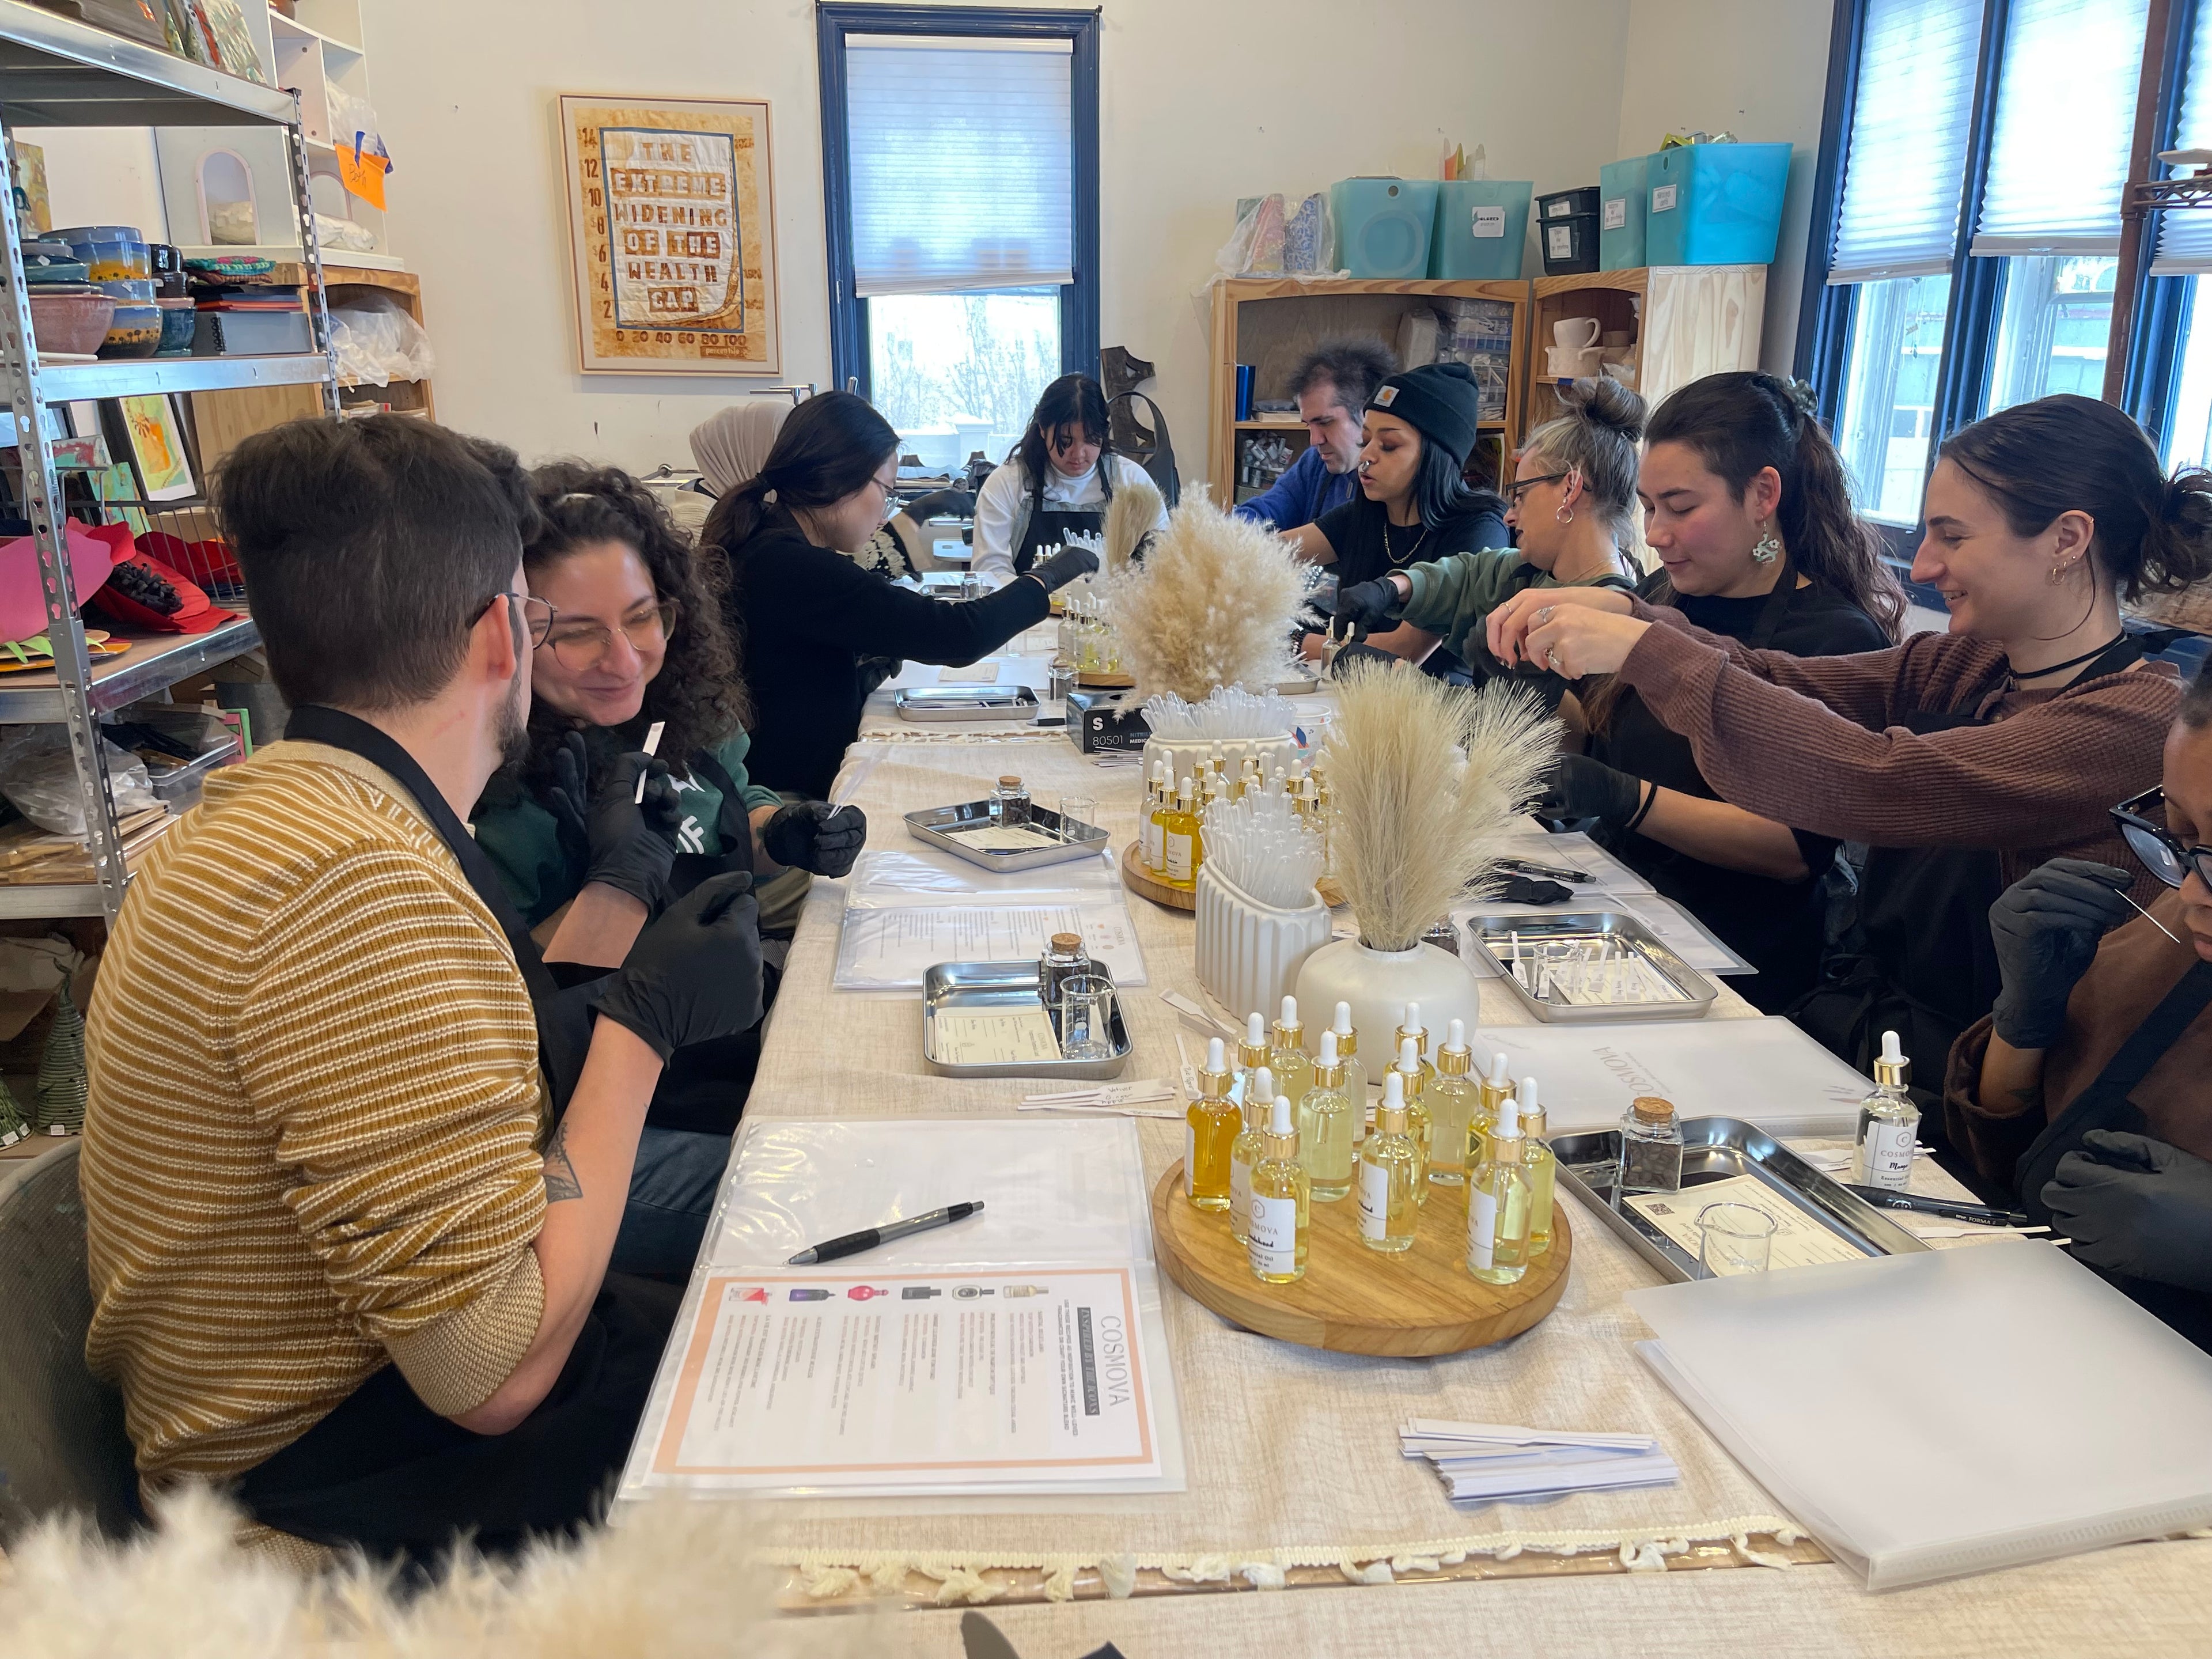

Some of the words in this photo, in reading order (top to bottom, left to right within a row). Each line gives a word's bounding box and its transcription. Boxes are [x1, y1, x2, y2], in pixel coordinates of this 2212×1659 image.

[642, 143, 691, 162] THE
[615, 173, 721, 196] EXTREME
[614, 203, 728, 227] WIDENING
[627, 233, 656, 251] OF
[673, 235, 718, 253] THE
[628, 262, 718, 282] WEALTH
[651, 290, 695, 310] GAP
[616, 331, 624, 341] 0
[632, 331, 649, 343] 20
[656, 332, 672, 343] 40
[677, 332, 695, 344] 60
[701, 334, 719, 345] 80
[724, 335, 747, 346] 100
[1093, 717, 1103, 731] S
[1092, 735, 1123, 746] 80501
[1880, 1149, 1912, 1158] COSMO
[1251, 1218, 1278, 1236] SMOVA
[1081, 1309, 1092, 1351] INSPIRED
[1084, 1352, 1094, 1363] BY
[1101, 1316, 1130, 1406] COSMOVA
[1085, 1366, 1096, 1384] THE
[1087, 1385, 1098, 1414] ICONS
